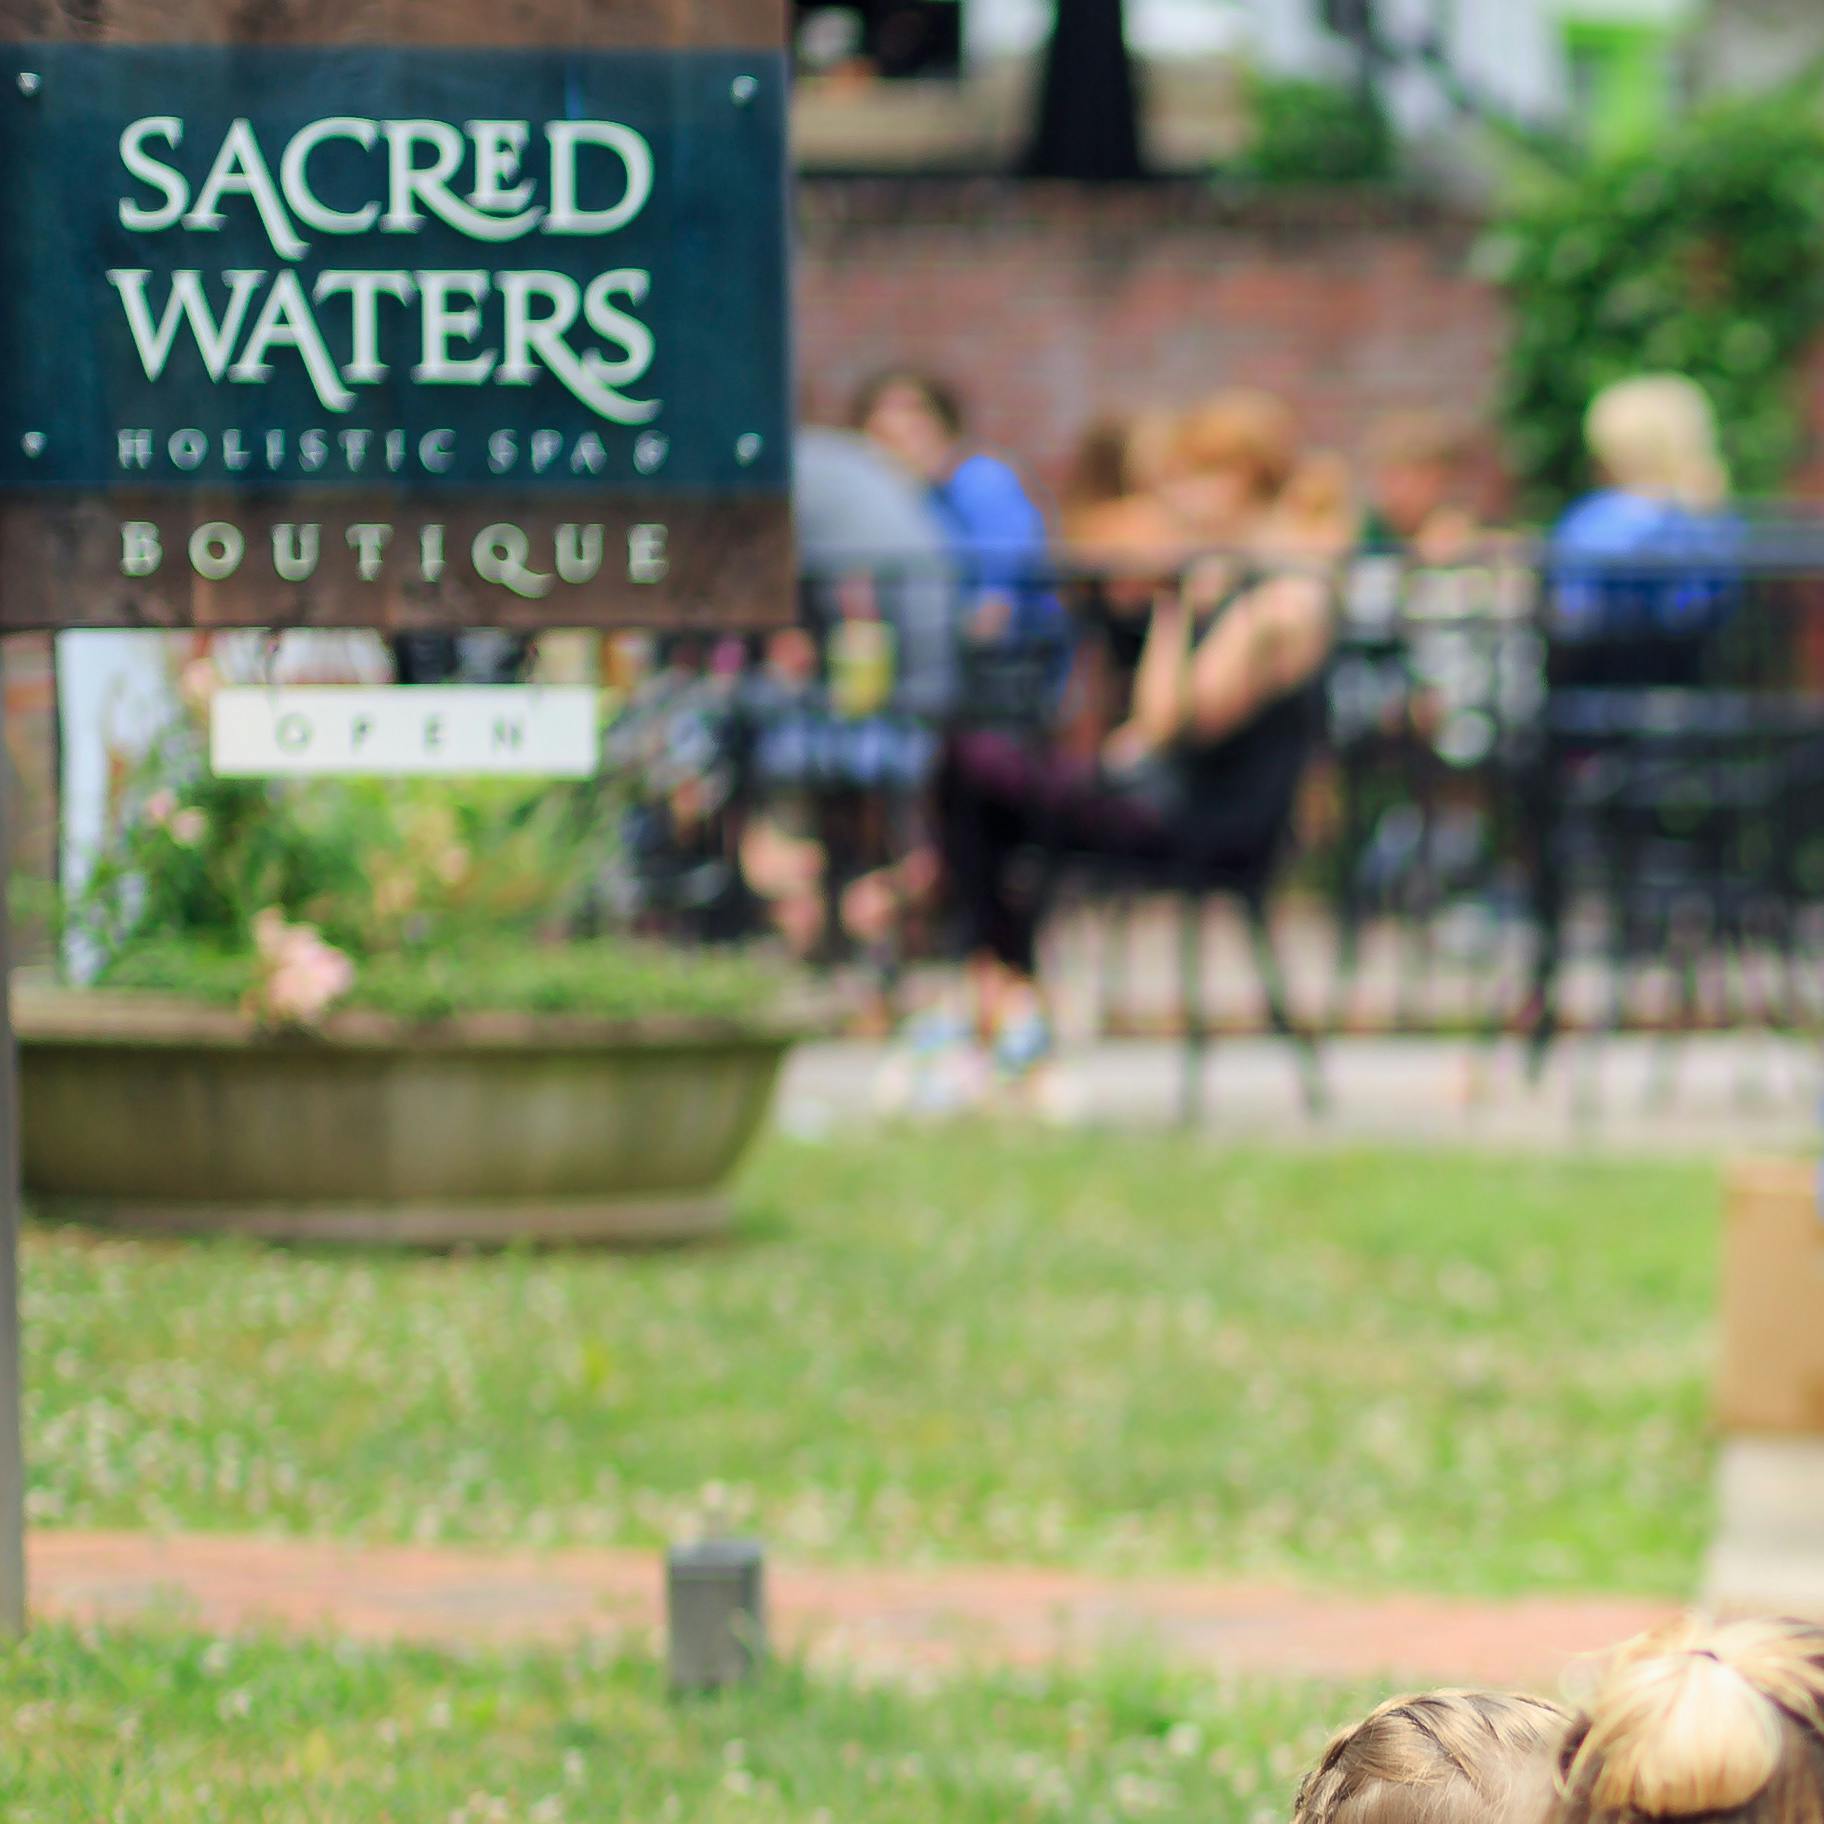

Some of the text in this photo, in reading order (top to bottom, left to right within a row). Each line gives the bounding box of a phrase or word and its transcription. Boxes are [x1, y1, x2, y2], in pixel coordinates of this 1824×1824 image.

[118, 116, 655, 261] SACRED
[105, 269, 664, 424] WATERS
[118, 429, 456, 474] HOLISTIC
[488, 429, 607, 474] SPA
[120, 521, 670, 599] BOUTIQUE
[275, 713, 526, 752] OPEN
